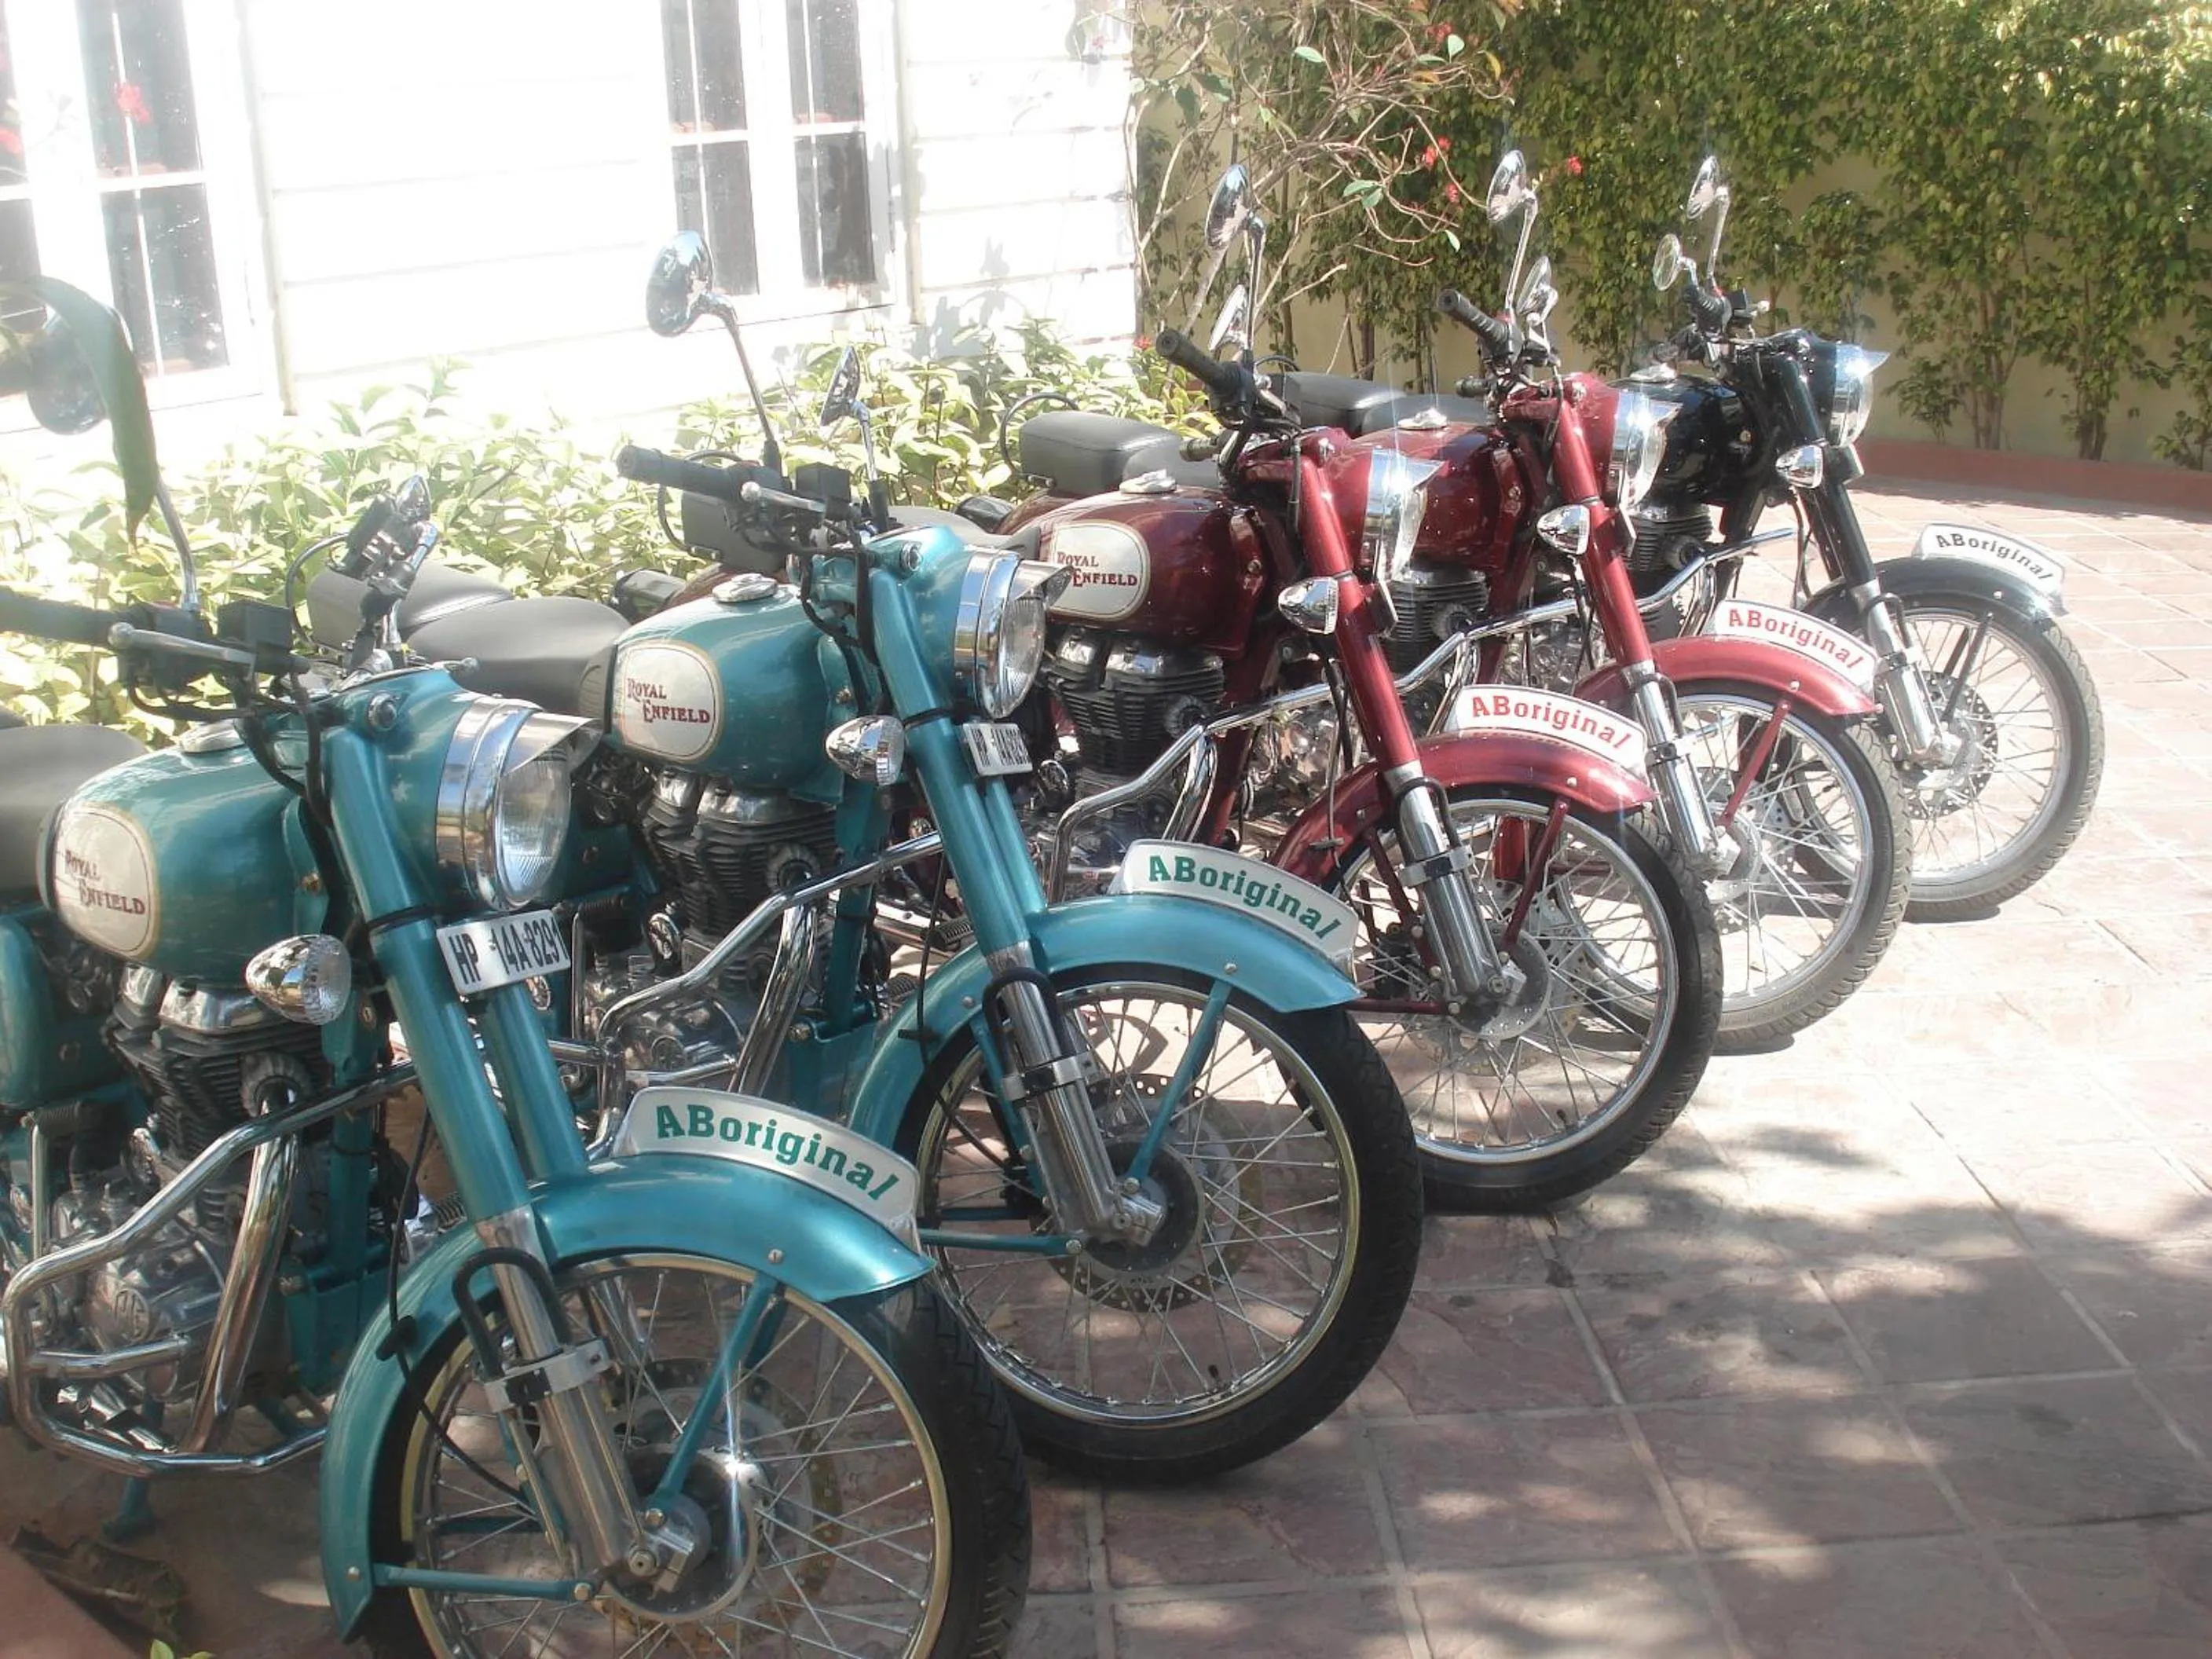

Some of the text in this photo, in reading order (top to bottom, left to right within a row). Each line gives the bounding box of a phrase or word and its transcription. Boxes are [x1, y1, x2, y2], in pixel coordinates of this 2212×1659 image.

[1057, 551, 1099, 567] ROYAL
[1936, 533, 2053, 580] ABoriginal
[1073, 568, 1137, 587] ENFIELD
[1729, 609, 1864, 668] ABoriginal
[627, 678, 667, 702] ROYAL
[643, 699, 710, 723] ENFIELD
[1472, 695, 1632, 749] ABoriginal
[65, 849, 100, 881] ROYAL
[79, 879, 145, 914] ENFIELD
[1148, 855, 1340, 939] ABoriginal
[449, 933, 482, 984] HP
[656, 1104, 899, 1201] ABoriginal
